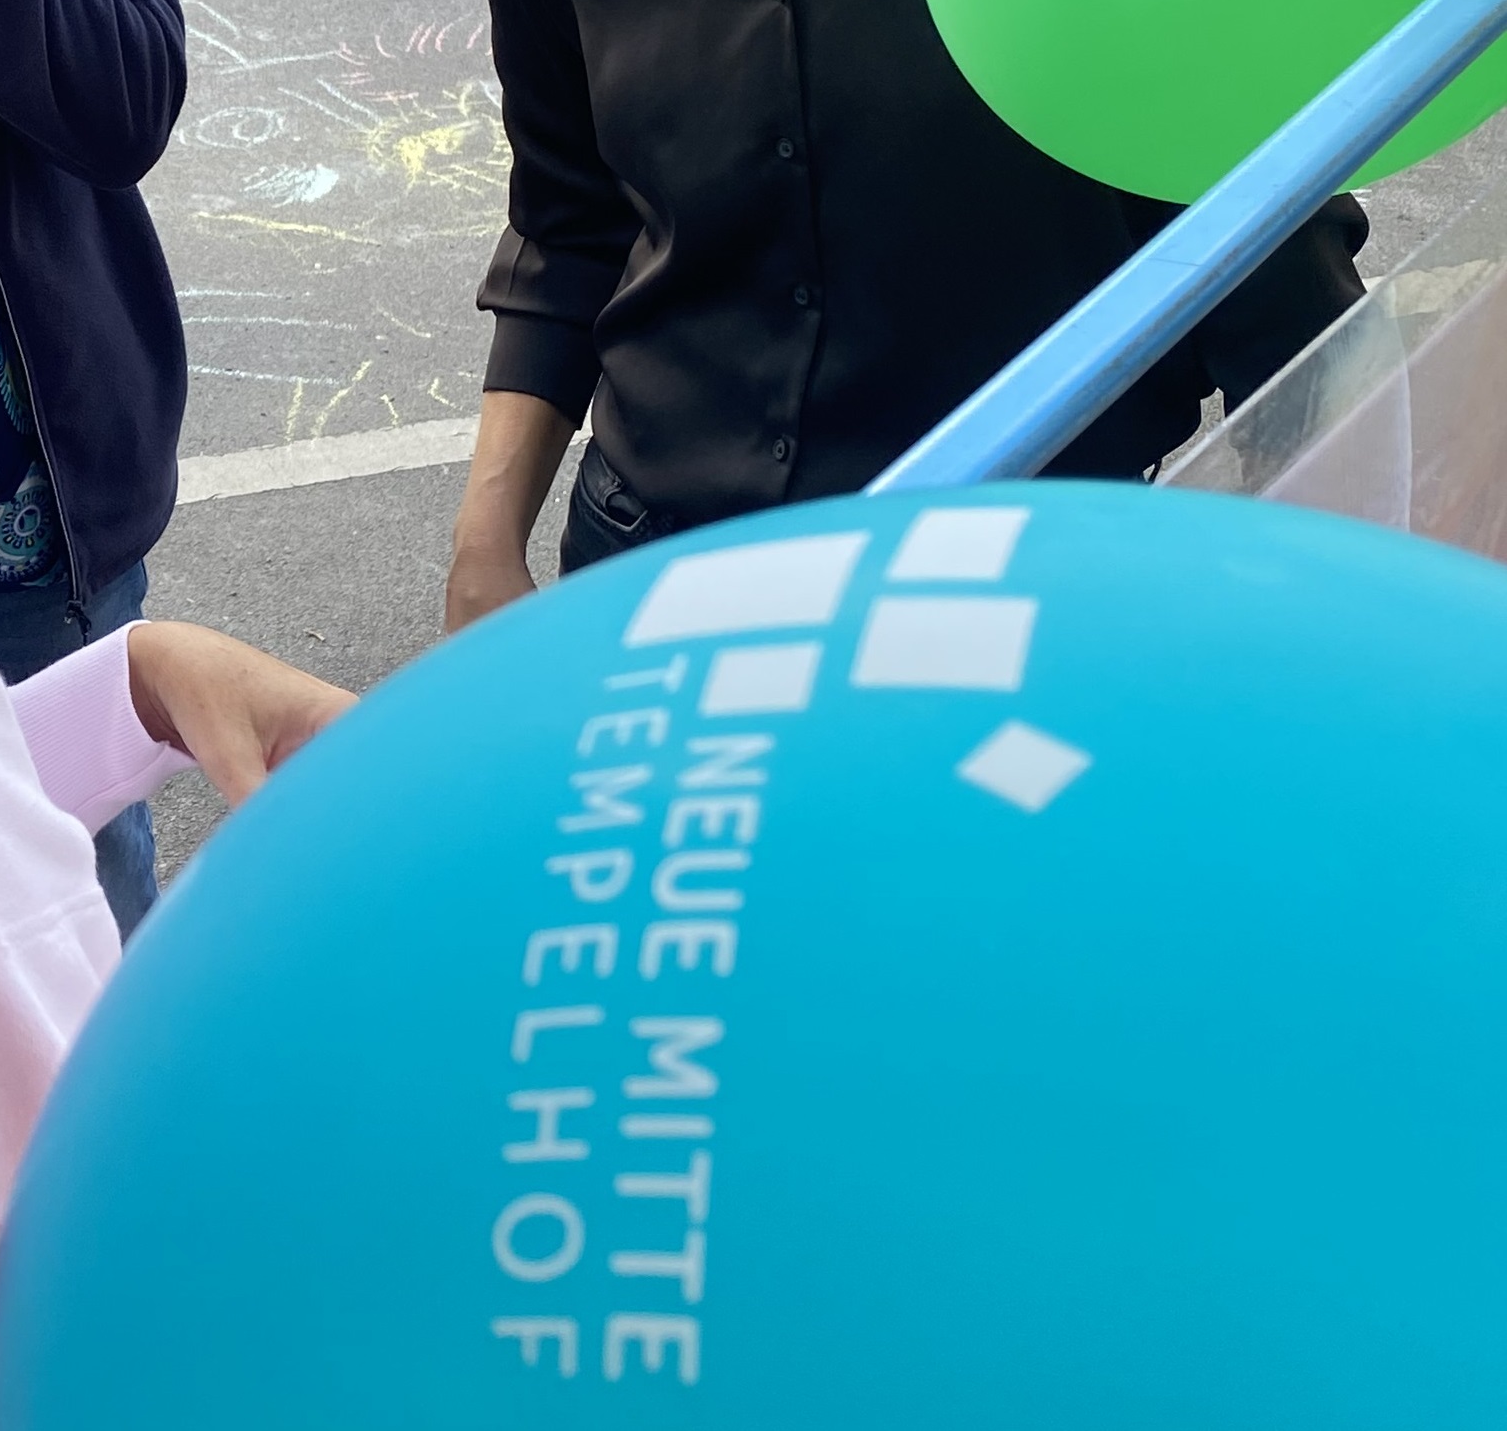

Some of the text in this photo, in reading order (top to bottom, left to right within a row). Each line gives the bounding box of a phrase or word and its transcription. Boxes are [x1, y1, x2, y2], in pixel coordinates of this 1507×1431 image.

[490, 651, 692, 1383] TEMPELHOF
[601, 732, 777, 1387] NEUE MITTE
